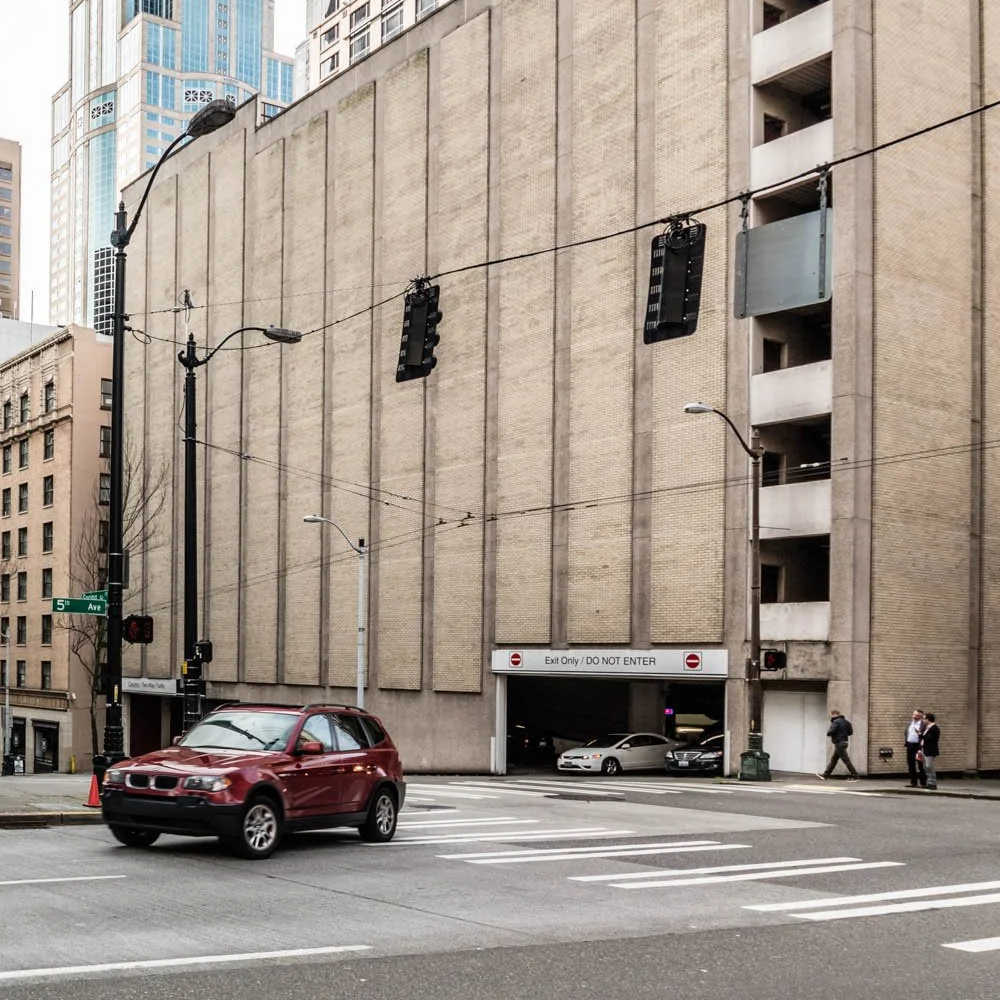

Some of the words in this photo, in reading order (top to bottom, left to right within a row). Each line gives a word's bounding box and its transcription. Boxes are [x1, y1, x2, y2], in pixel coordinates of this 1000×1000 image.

[88, 603, 101, 611] Ave
[544, 656, 559, 665] Exit
[560, 656, 579, 667] Only
[586, 656, 600, 665] DO
[601, 656, 621, 665] NOT
[623, 656, 656, 666] ENTER
